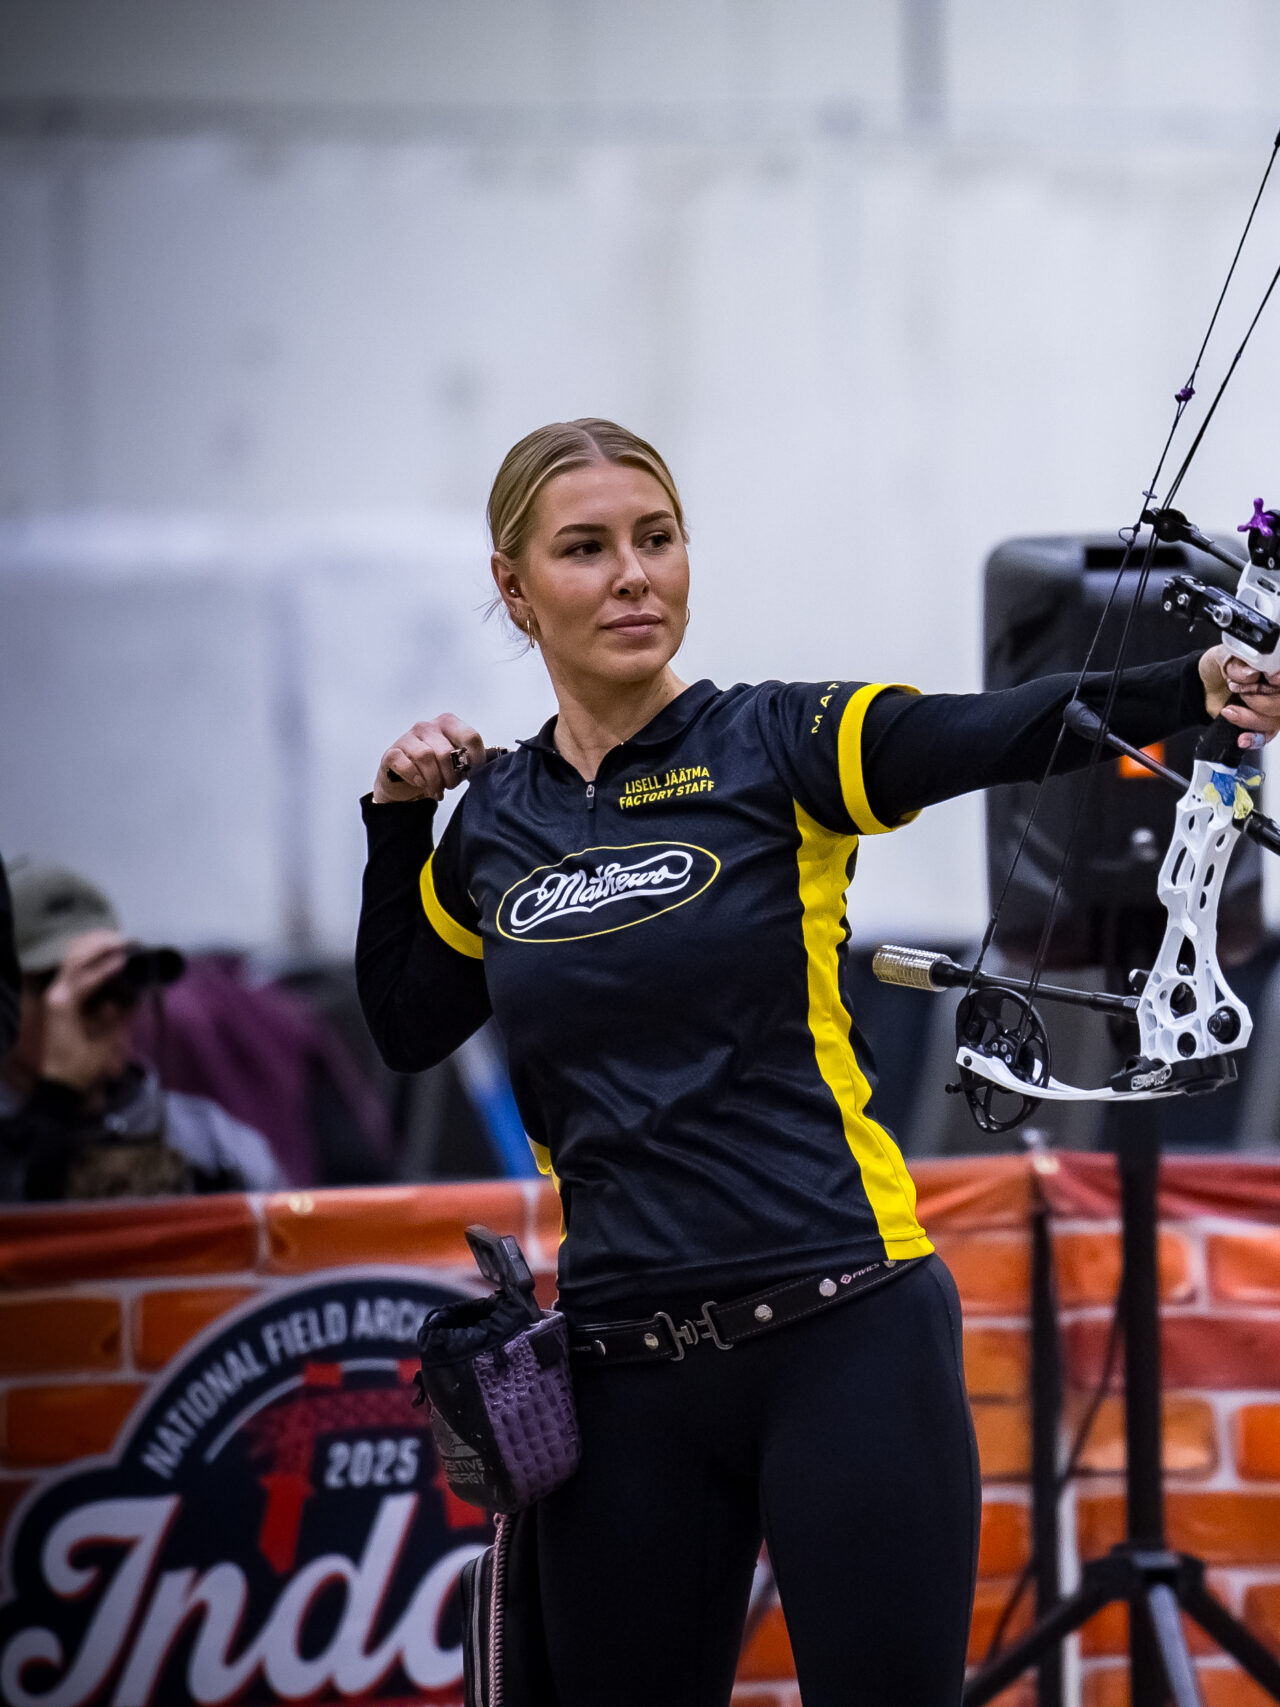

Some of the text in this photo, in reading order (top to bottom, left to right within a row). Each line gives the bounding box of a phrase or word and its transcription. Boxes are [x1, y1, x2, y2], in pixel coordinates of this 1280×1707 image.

[811, 683, 839, 734] MAT
[619, 779, 715, 810] FACTORY STAFF
[625, 765, 710, 795] LISELL JÄÄTMA
[511, 851, 693, 932] Mathews
[141, 1297, 425, 1479] NATIONAL FIELD ARC
[324, 1438, 418, 1488] 2025
